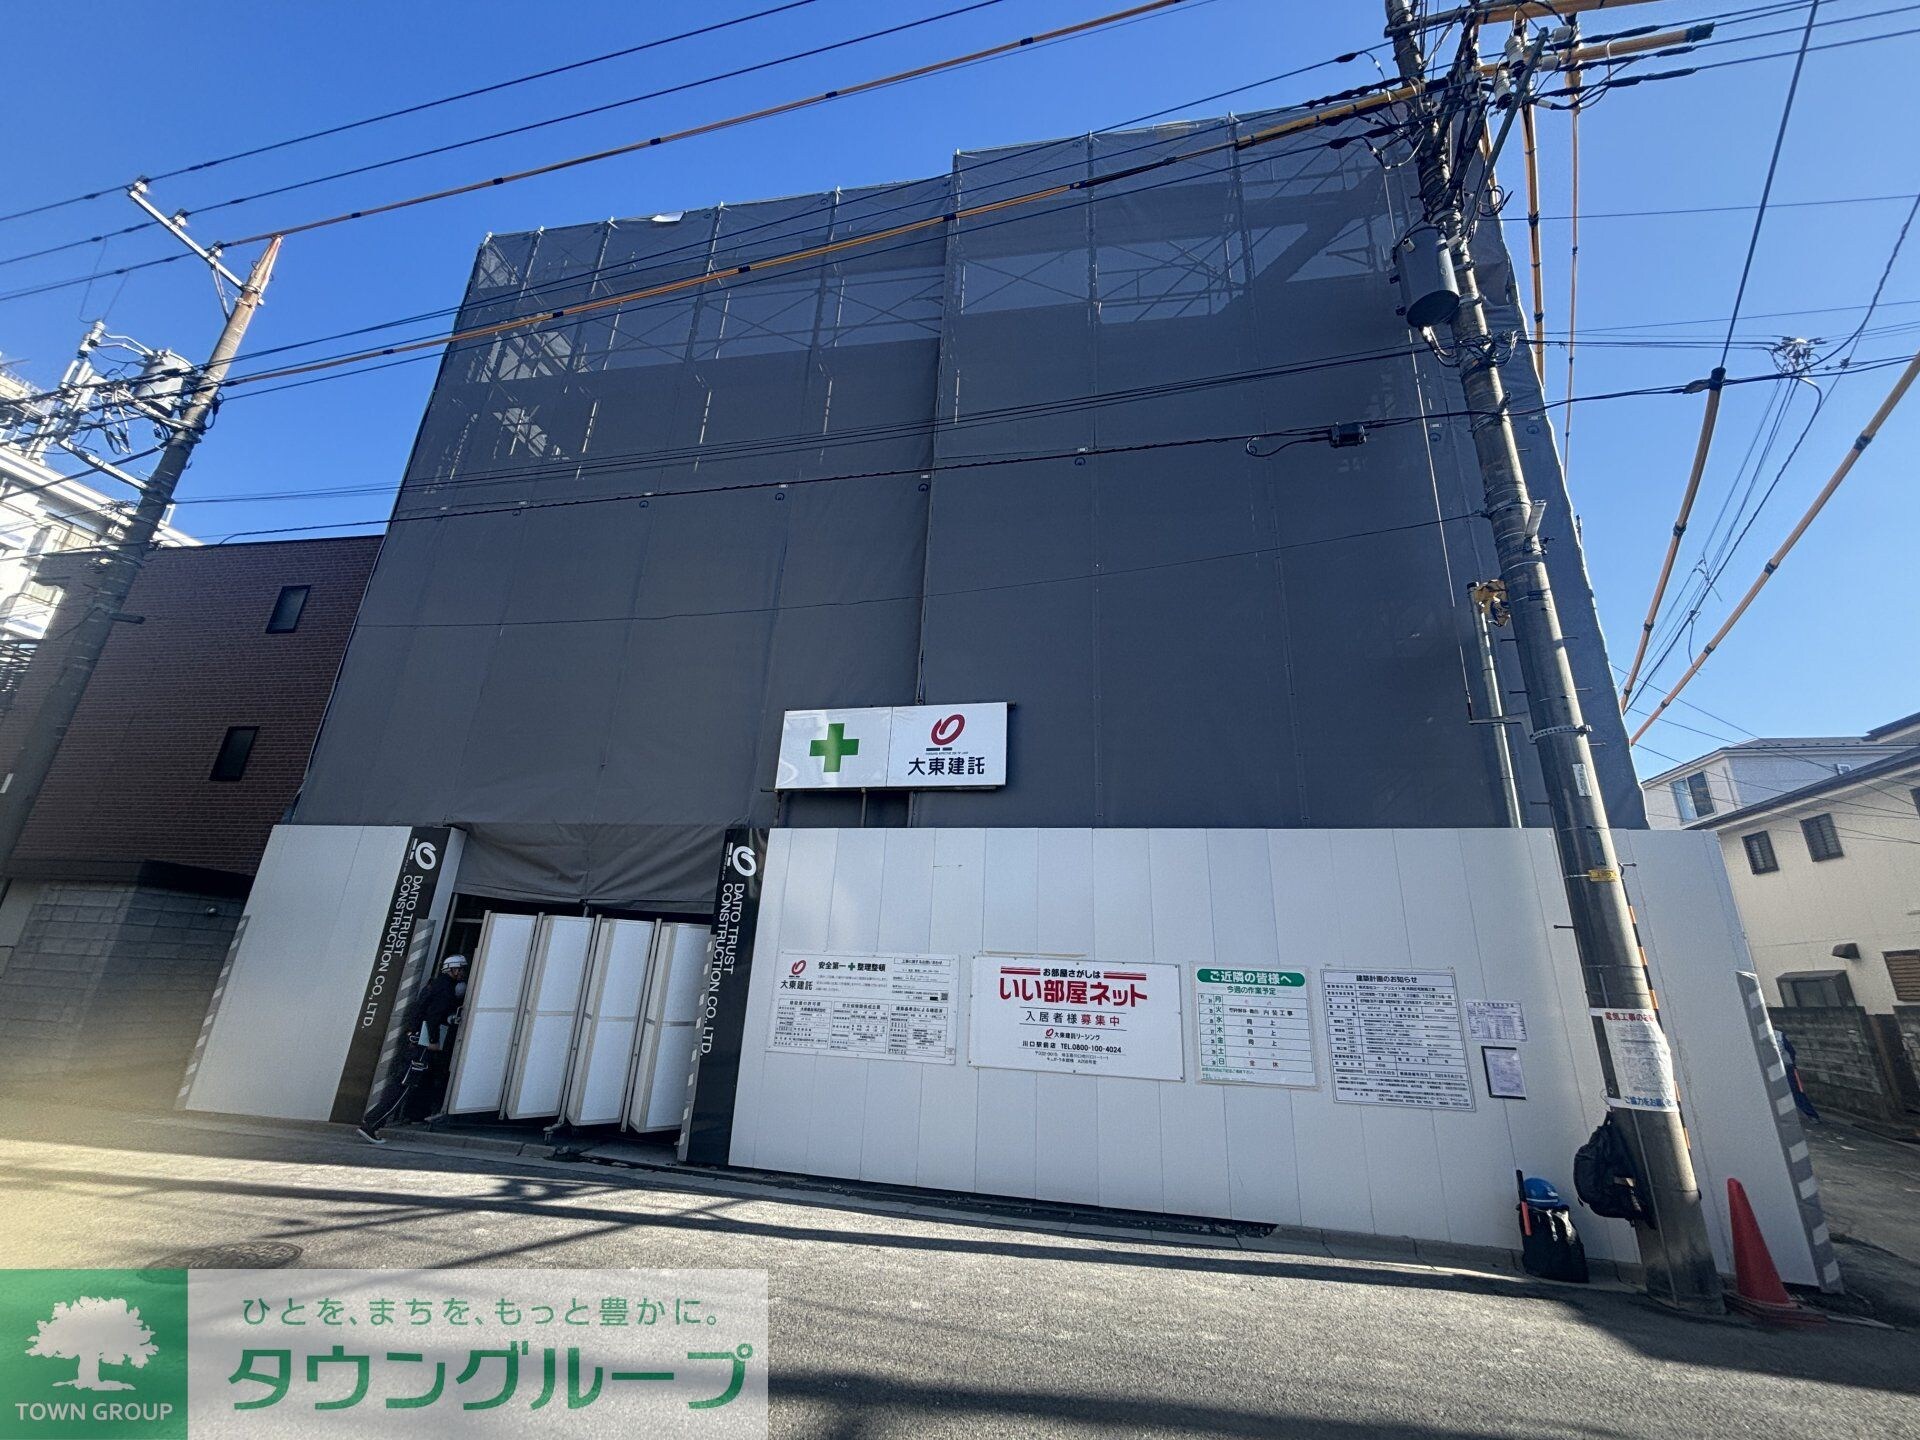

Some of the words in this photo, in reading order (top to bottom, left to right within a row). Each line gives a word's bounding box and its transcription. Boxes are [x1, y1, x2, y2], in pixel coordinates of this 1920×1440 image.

[908, 756, 985, 776] 大東建託
[405, 875, 423, 911] DAITO
[730, 883, 745, 923] DAITO
[377, 874, 412, 973] CONSTRUCTION
[394, 912, 413, 957] TRUST
[709, 882, 733, 993] CONSTRUCTION
[723, 926, 740, 974] TRUST
[818, 961, 846, 970] 安全第一
[857, 962, 886, 972] 整理整頓
[1043, 968, 1101, 979] お部屋さがしは
[780, 979, 814, 991] 大東建託
[1209, 970, 1292, 985] ご近隣の皆様へ
[1356, 974, 1418, 984] 建築計画のお知らせ
[999, 977, 1148, 1007] いい部屋ネット
[1227, 985, 1276, 995] 今週の作業予定
[361, 1001, 377, 1029] LTD.
[1025, 1010, 1120, 1027] 入居者様募集中
[700, 1025, 715, 1056] LTD.
[1022, 1040, 1057, 1049] 川口駅前店
[1054, 1032, 1101, 1041] 大東建託リーシング
